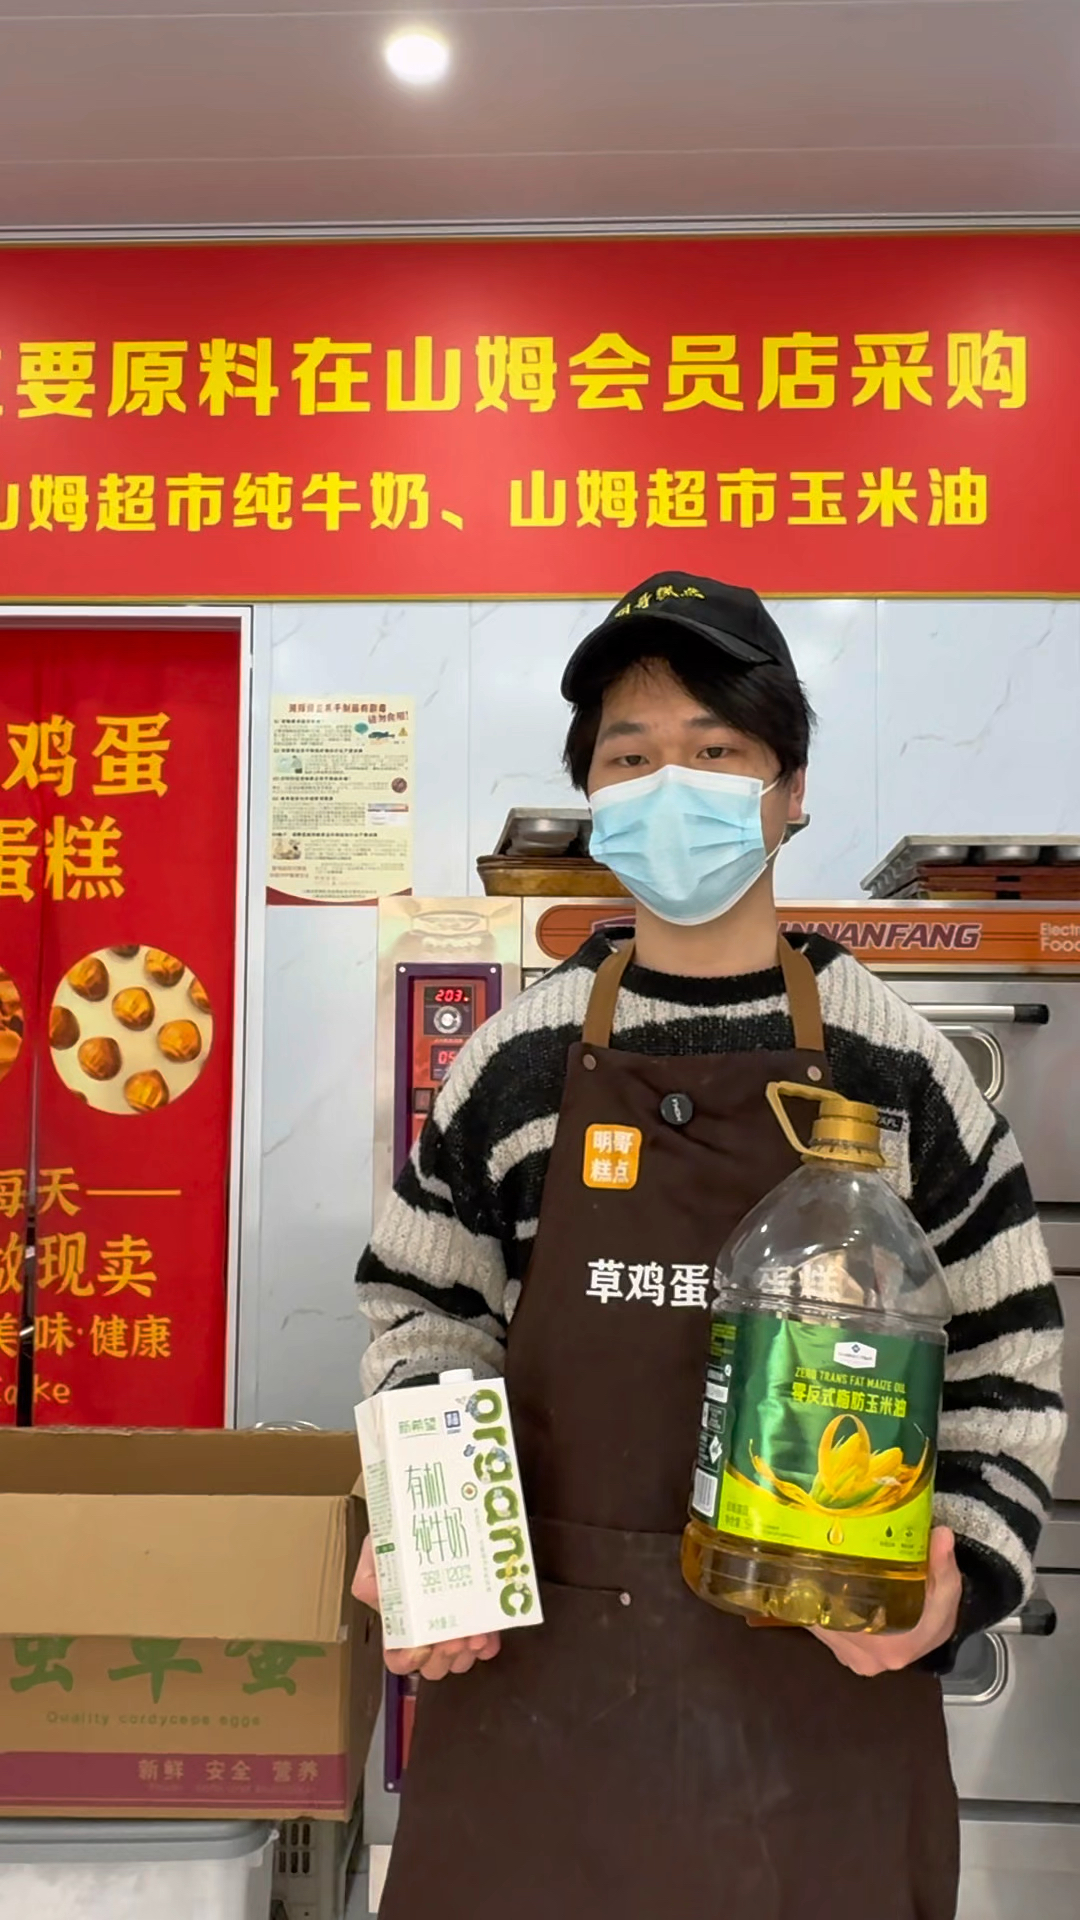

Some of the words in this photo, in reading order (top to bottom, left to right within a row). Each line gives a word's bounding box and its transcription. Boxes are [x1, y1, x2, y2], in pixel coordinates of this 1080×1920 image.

[0, 329, 1027, 419] 要原料在山姆会员店采购
[2, 712, 172, 798] 鸡蛋
[592, 1131, 633, 1154] 明哥
[590, 1159, 630, 1184] 糕点
[586, 1259, 710, 1309] 草鸡蛋
[0, 1373, 71, 1404] ake
[820, 1370, 848, 1385] TRANS
[849, 1375, 865, 1387] FAT
[791, 1381, 907, 1418] 零反式脂肪玉米油
[404, 1461, 449, 1509] 有机
[463, 1389, 533, 1617] organic
[46, 1710, 110, 1726] Quality
[138, 1759, 184, 1781] 新鲜
[205, 1760, 251, 1782] 安全
[272, 1760, 319, 1783] 营养
